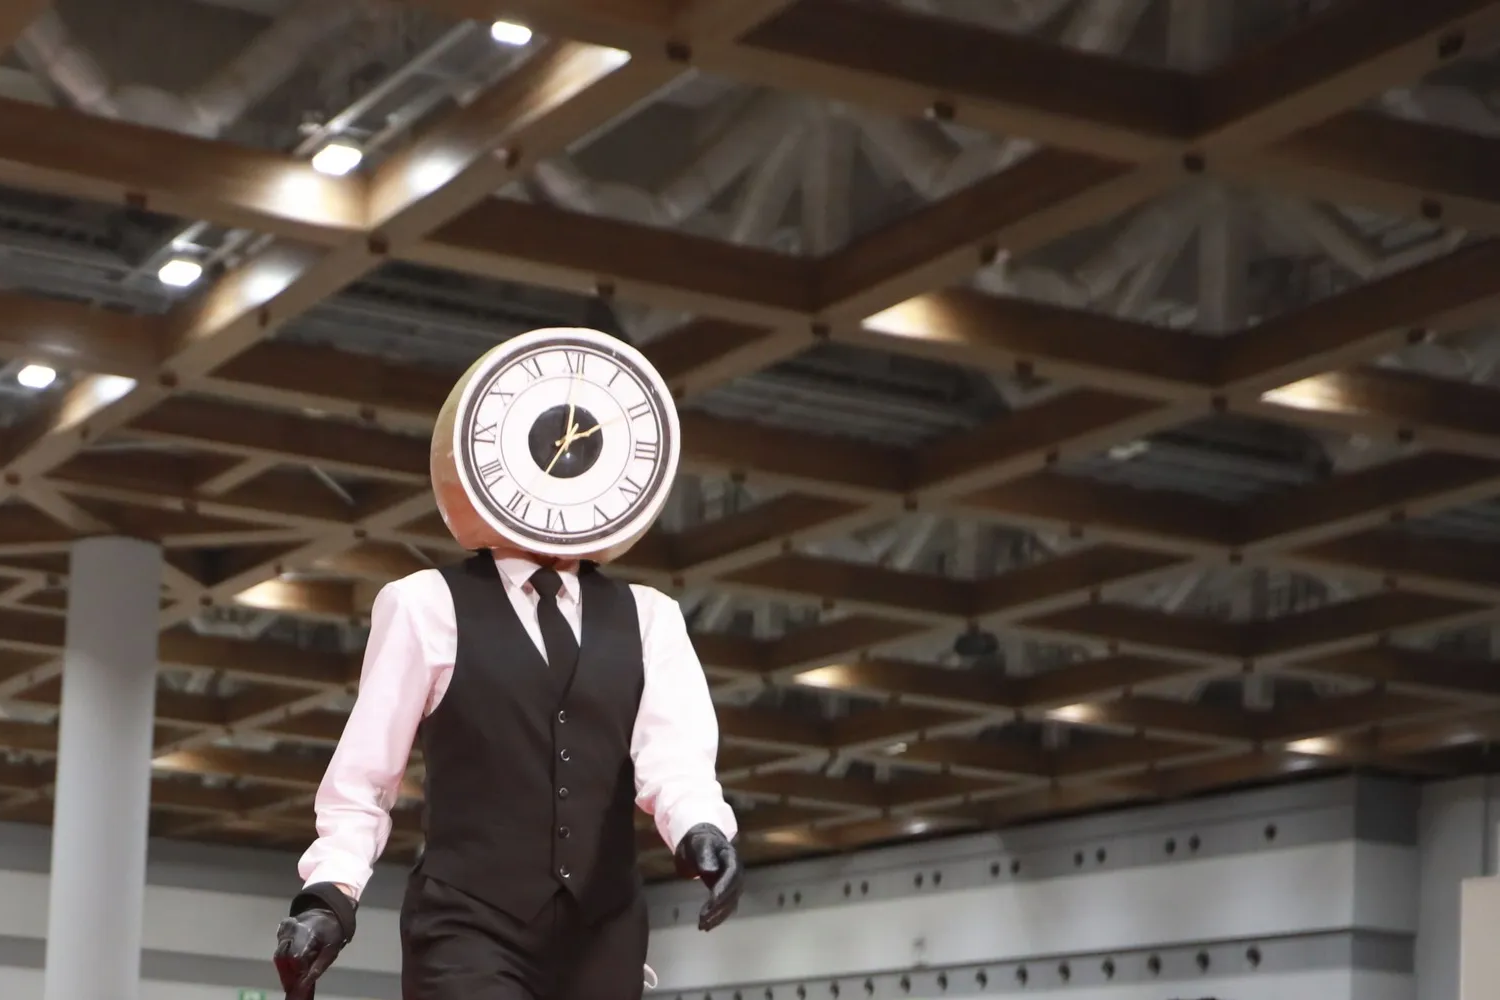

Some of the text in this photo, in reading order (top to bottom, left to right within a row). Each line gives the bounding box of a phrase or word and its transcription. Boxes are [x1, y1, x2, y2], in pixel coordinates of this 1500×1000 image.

[519, 357, 544, 384] XI
[563, 351, 586, 375] XII
[607, 369, 621, 387] I
[488, 382, 515, 407] X
[627, 400, 651, 421] II
[474, 421, 498, 444] IX
[635, 440, 658, 462] III
[479, 458, 505, 488] VIII
[618, 476, 642, 505] IV
[506, 490, 533, 521] VII
[592, 504, 612, 529] V
[545, 508, 569, 532] VI
